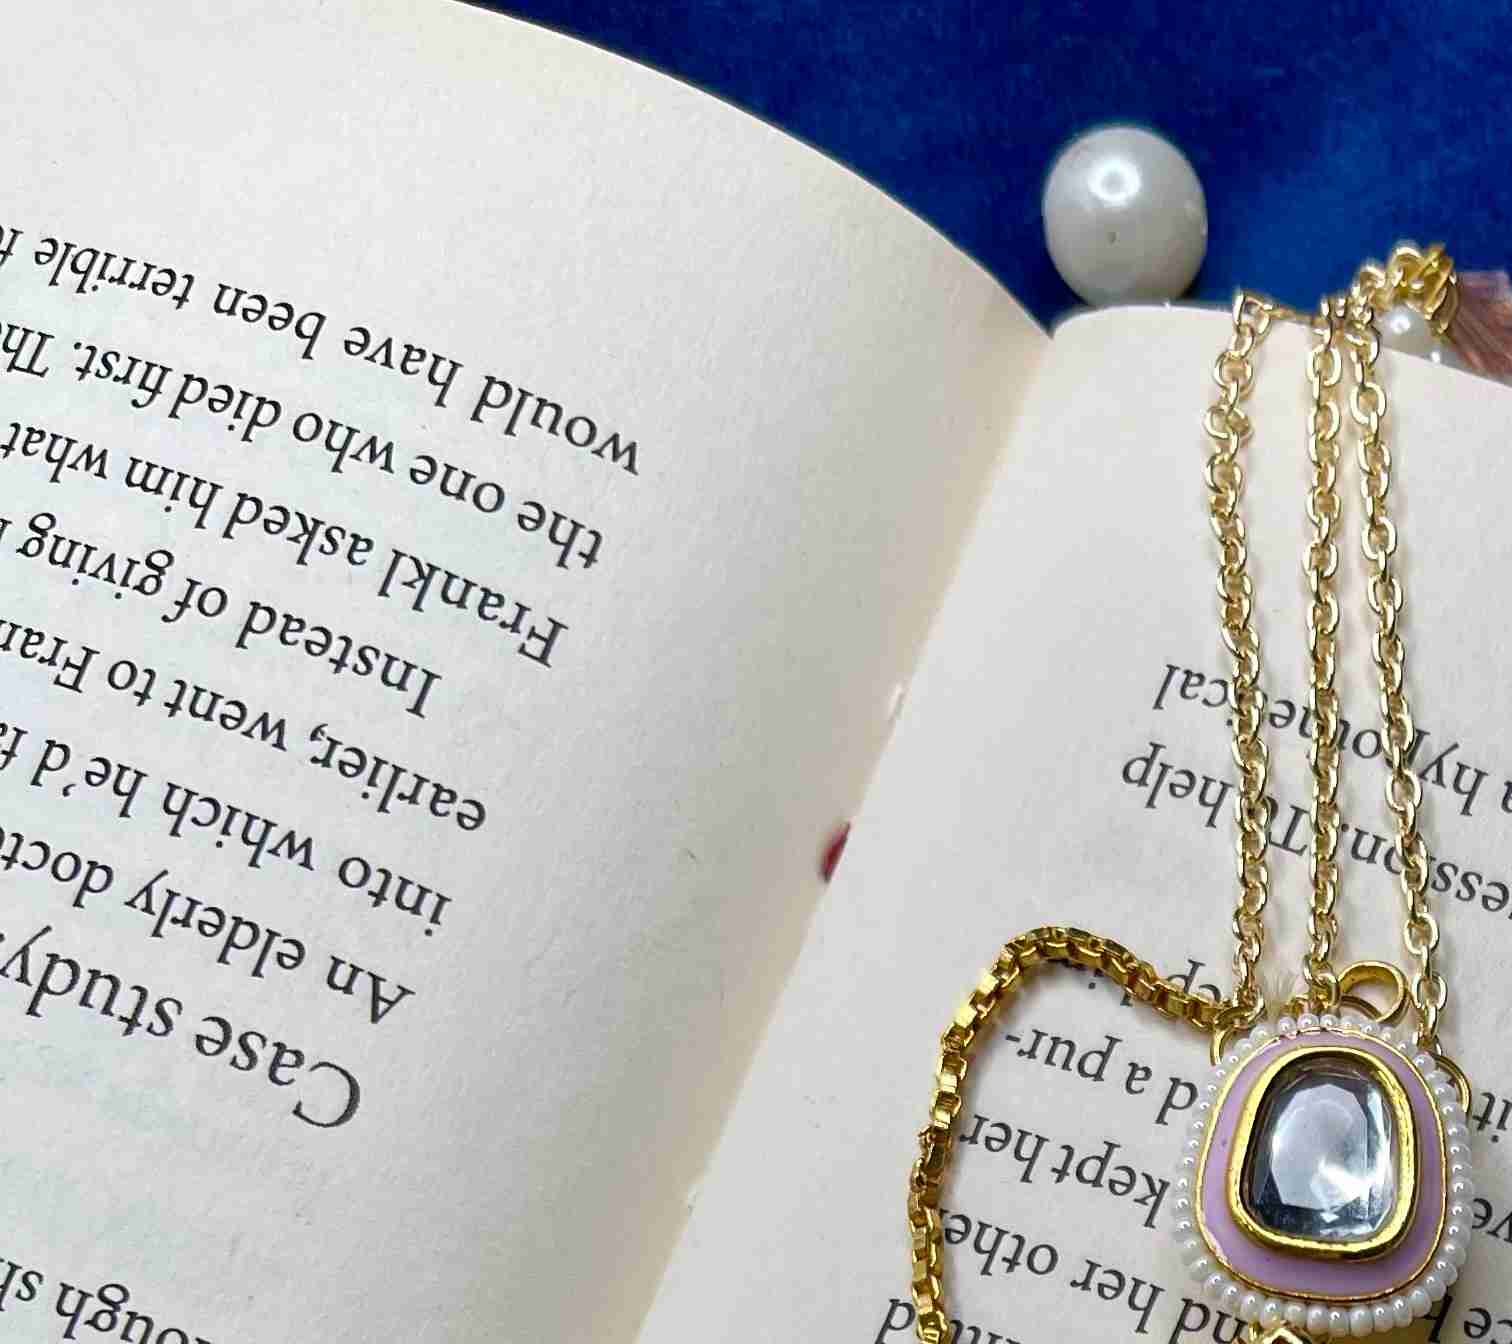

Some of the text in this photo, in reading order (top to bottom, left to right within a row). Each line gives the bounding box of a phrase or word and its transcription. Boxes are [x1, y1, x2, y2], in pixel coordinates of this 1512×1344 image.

[33, 236, 195, 310] terrible
[212, 282, 327, 361] been
[72, 340, 174, 409] first.
[166, 372, 282, 443] died
[342, 325, 464, 409] have
[291, 411, 394, 474] who
[468, 374, 639, 476] would
[408, 453, 505, 513] one
[0, 421, 569, 668] Frankl asked him what
[516, 499, 603, 570] the
[14, 511, 442, 720] Instead of giving
[106, 658, 486, 831] earlier, went to
[1121, 740, 1236, 829] help
[161, 780, 315, 872] which
[337, 855, 452, 937] into
[122, 868, 416, 1025] An elderly
[194, 1015, 361, 1128] Case
[956, 1113, 1049, 1183] her
[1049, 1139, 1171, 1229] kept
